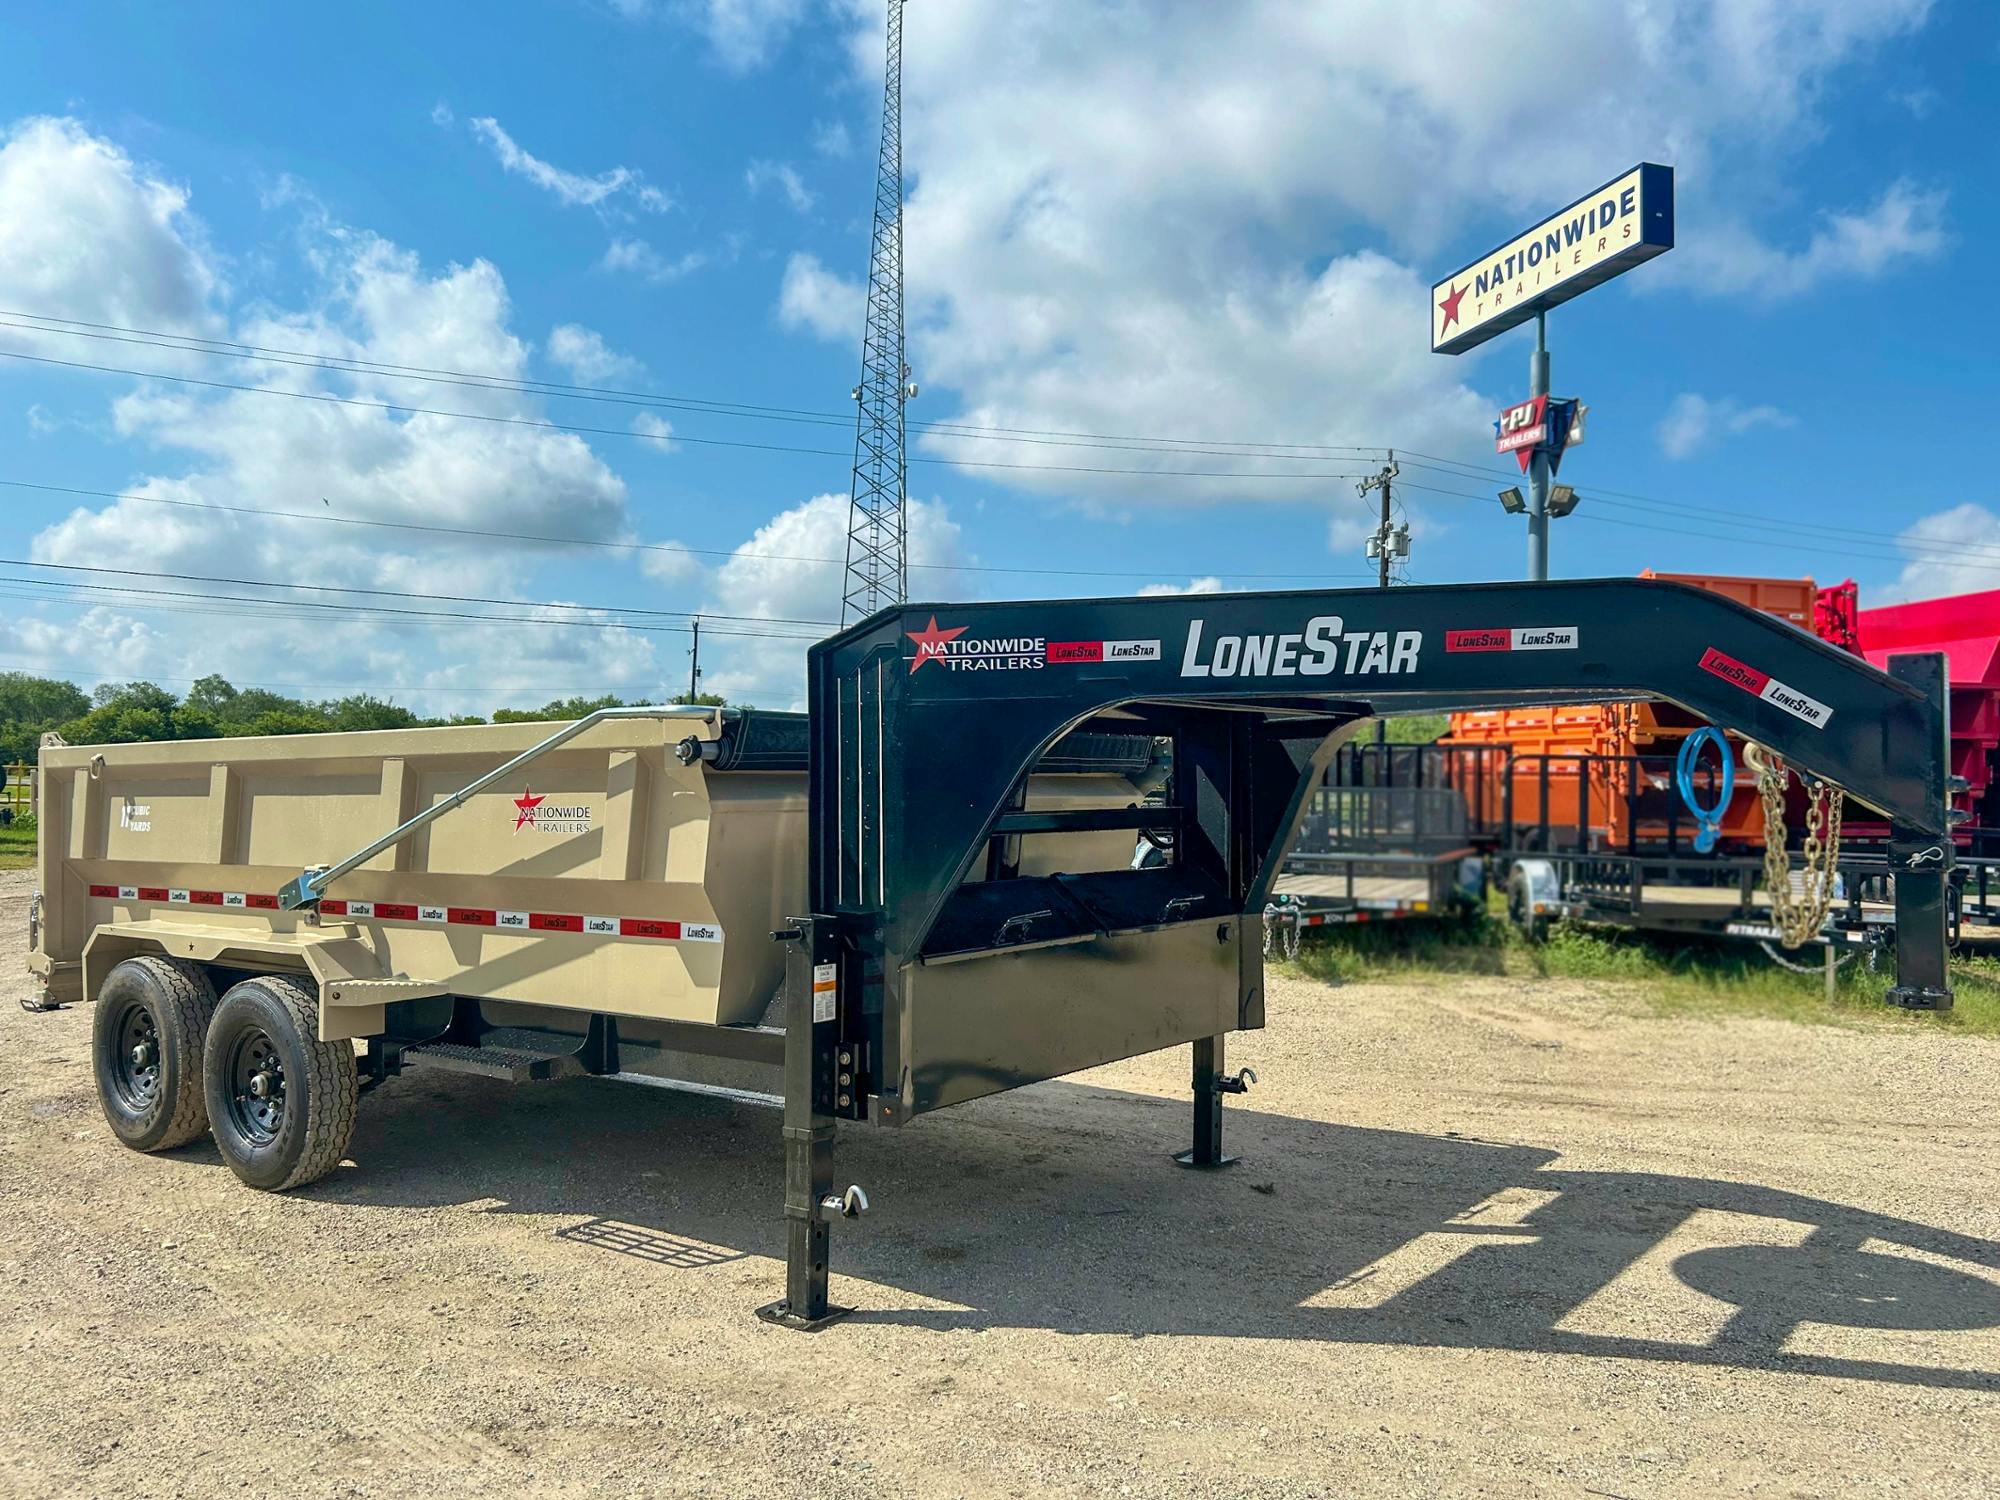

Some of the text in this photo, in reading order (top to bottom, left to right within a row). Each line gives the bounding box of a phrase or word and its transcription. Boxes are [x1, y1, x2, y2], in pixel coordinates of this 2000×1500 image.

[1475, 186, 1636, 298] NATIONWIDE
[1477, 223, 1631, 316] TRAILERS
[1509, 403, 1534, 430] PJ
[1499, 429, 1540, 449] TRAILERS
[921, 638, 1046, 655] NATIONWIDE
[946, 657, 1044, 672] TRAILERS
[521, 807, 591, 818] NATIONWIDE
[537, 823, 590, 833] TRAILERS
